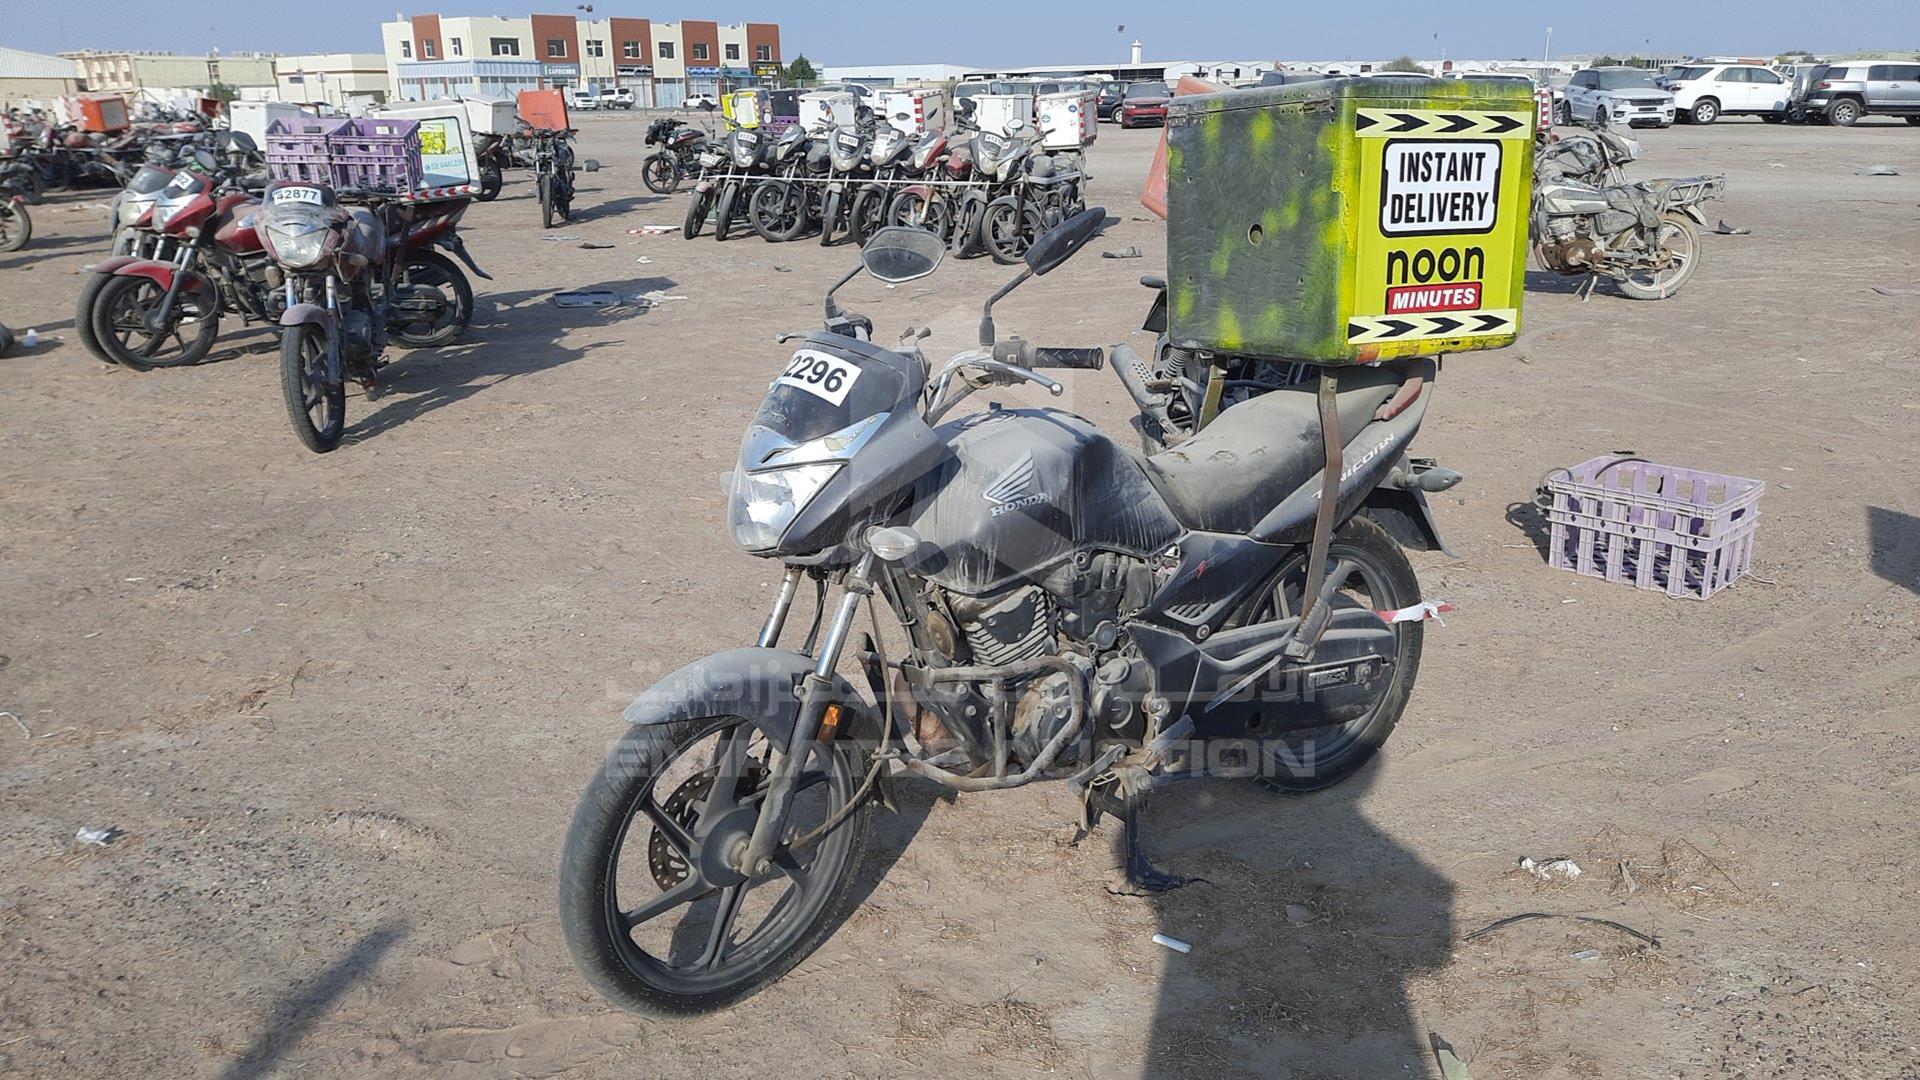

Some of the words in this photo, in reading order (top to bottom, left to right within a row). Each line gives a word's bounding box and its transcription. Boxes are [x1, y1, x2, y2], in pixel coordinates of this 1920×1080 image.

[1400, 151, 1486, 182] INSTANT
[276, 188, 318, 201] 42877
[1390, 192, 1489, 224] DELIVERY
[1386, 246, 1485, 285] noon
[1392, 288, 1476, 310] MINUTES
[991, 492, 1049, 517] HONDA
